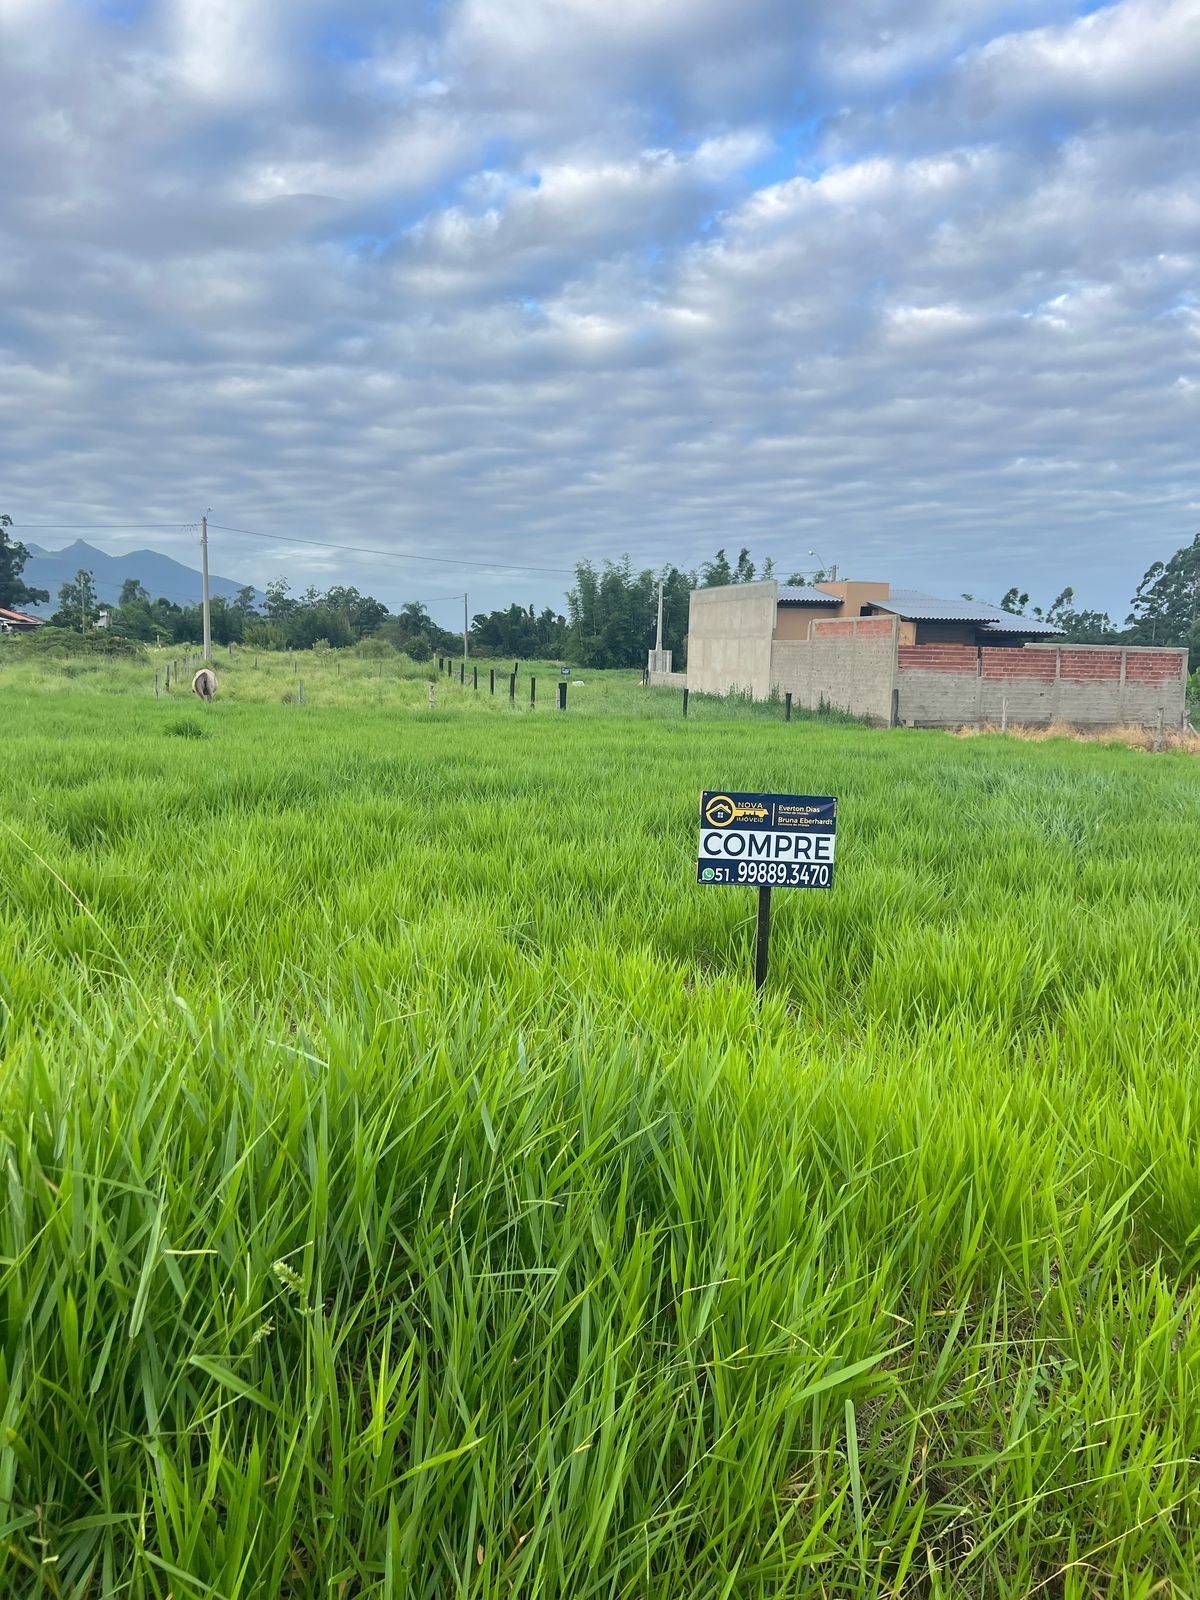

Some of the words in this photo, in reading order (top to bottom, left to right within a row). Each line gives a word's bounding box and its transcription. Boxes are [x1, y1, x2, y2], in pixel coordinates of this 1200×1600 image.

[778, 816, 798, 824] Bruna
[799, 817, 833, 825] Eberhardt
[703, 832, 831, 860] COMPRE
